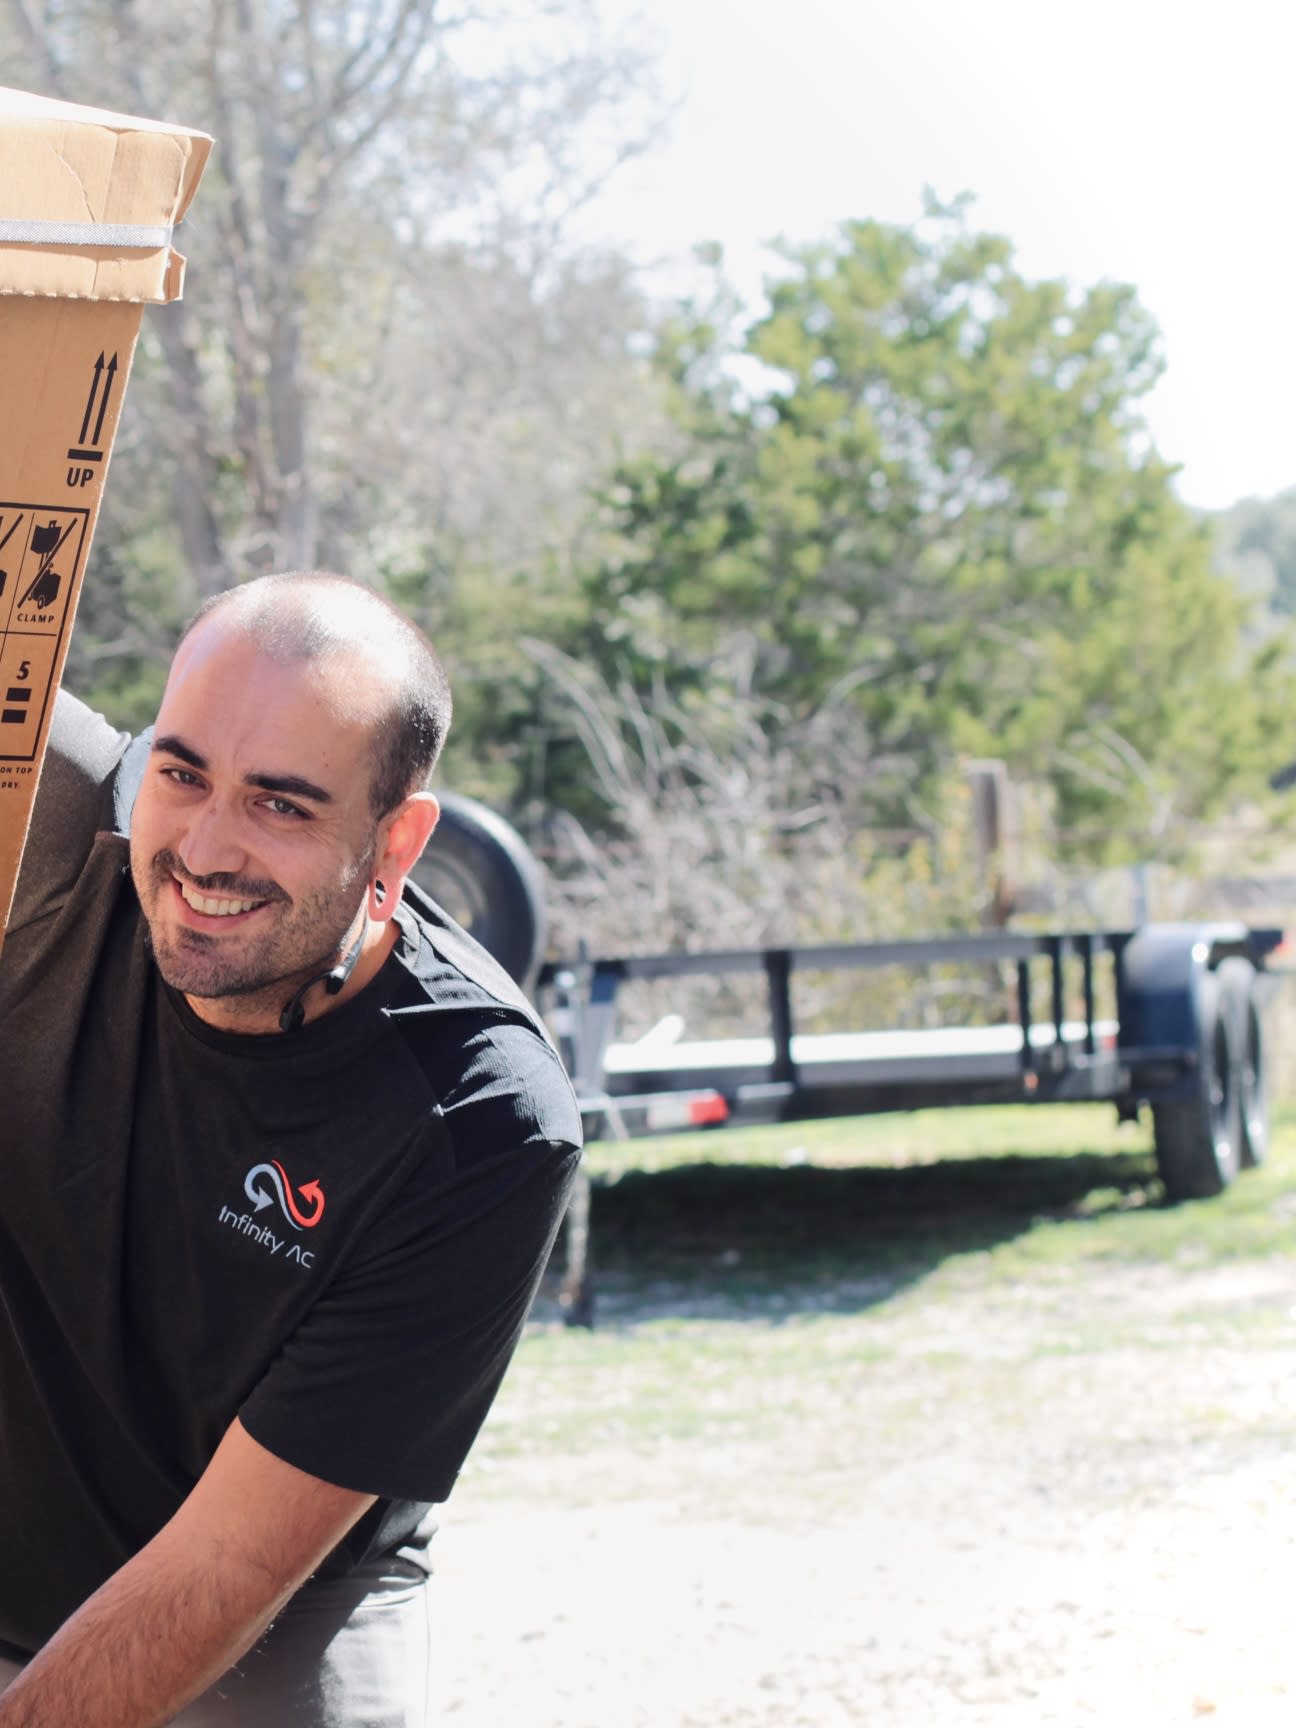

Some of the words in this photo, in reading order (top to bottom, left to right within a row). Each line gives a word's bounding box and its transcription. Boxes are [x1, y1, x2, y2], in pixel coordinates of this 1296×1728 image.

[66, 466, 94, 488] UP
[17, 613, 55, 624] CLAMP
[15, 660, 31, 681] 5
[0, 766, 12, 774] ON
[16, 767, 33, 775] TOP
[218, 1204, 285, 1254] Infinity
[285, 1244, 315, 1269] AC
